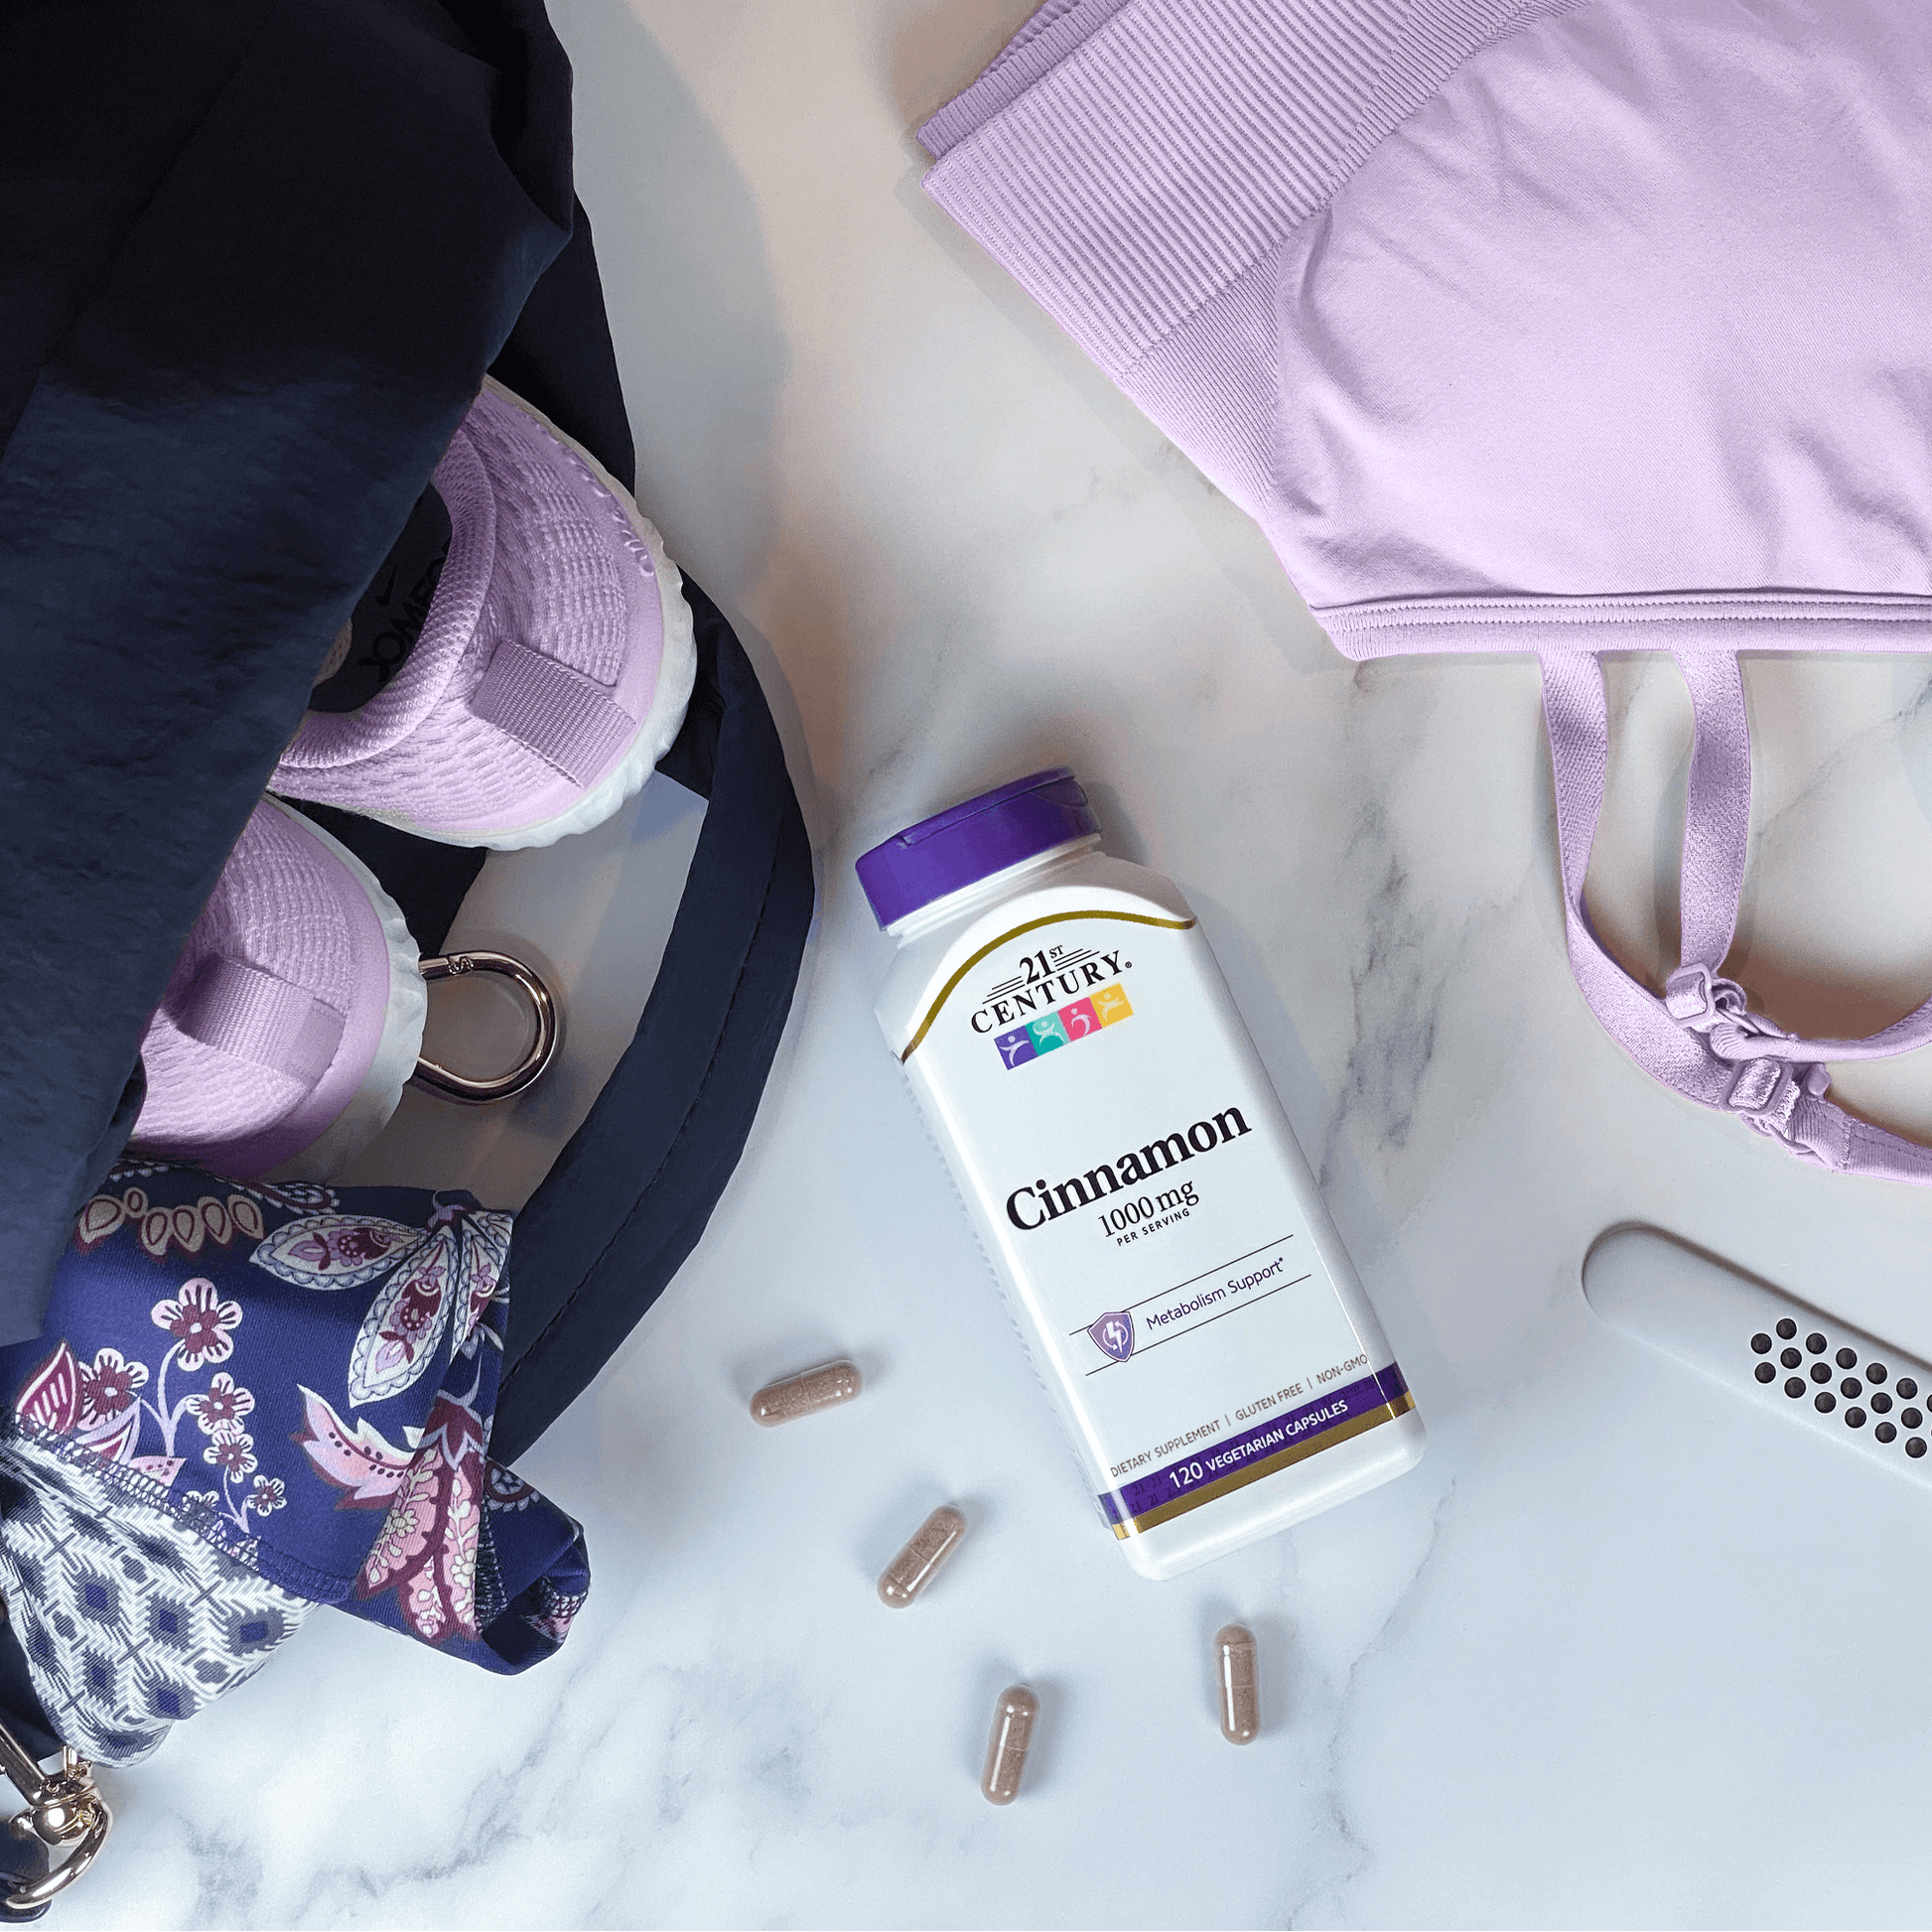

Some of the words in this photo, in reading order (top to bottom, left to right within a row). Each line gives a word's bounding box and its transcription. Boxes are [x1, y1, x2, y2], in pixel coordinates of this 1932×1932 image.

[1006, 1107, 1252, 1230] Cinnamon
[1098, 1196, 1155, 1237] 1000
[1156, 1181, 1199, 1212] mg
[1117, 1231, 1138, 1246] PER
[1142, 1207, 1190, 1235] SERVING
[1147, 1288, 1226, 1330] Metabolism
[1110, 1450, 1152, 1477] DIETARY
[1155, 1420, 1221, 1457] SUPPLEMENT
[1235, 1395, 1277, 1421] GLUTEN
[1277, 1383, 1304, 1403] FREE
[1316, 1353, 1368, 1384] NON-GMO
[1169, 1461, 1203, 1488] 120
[1205, 1429, 1285, 1471] VEGETARIAN
[1286, 1400, 1348, 1436] CAPSULES
